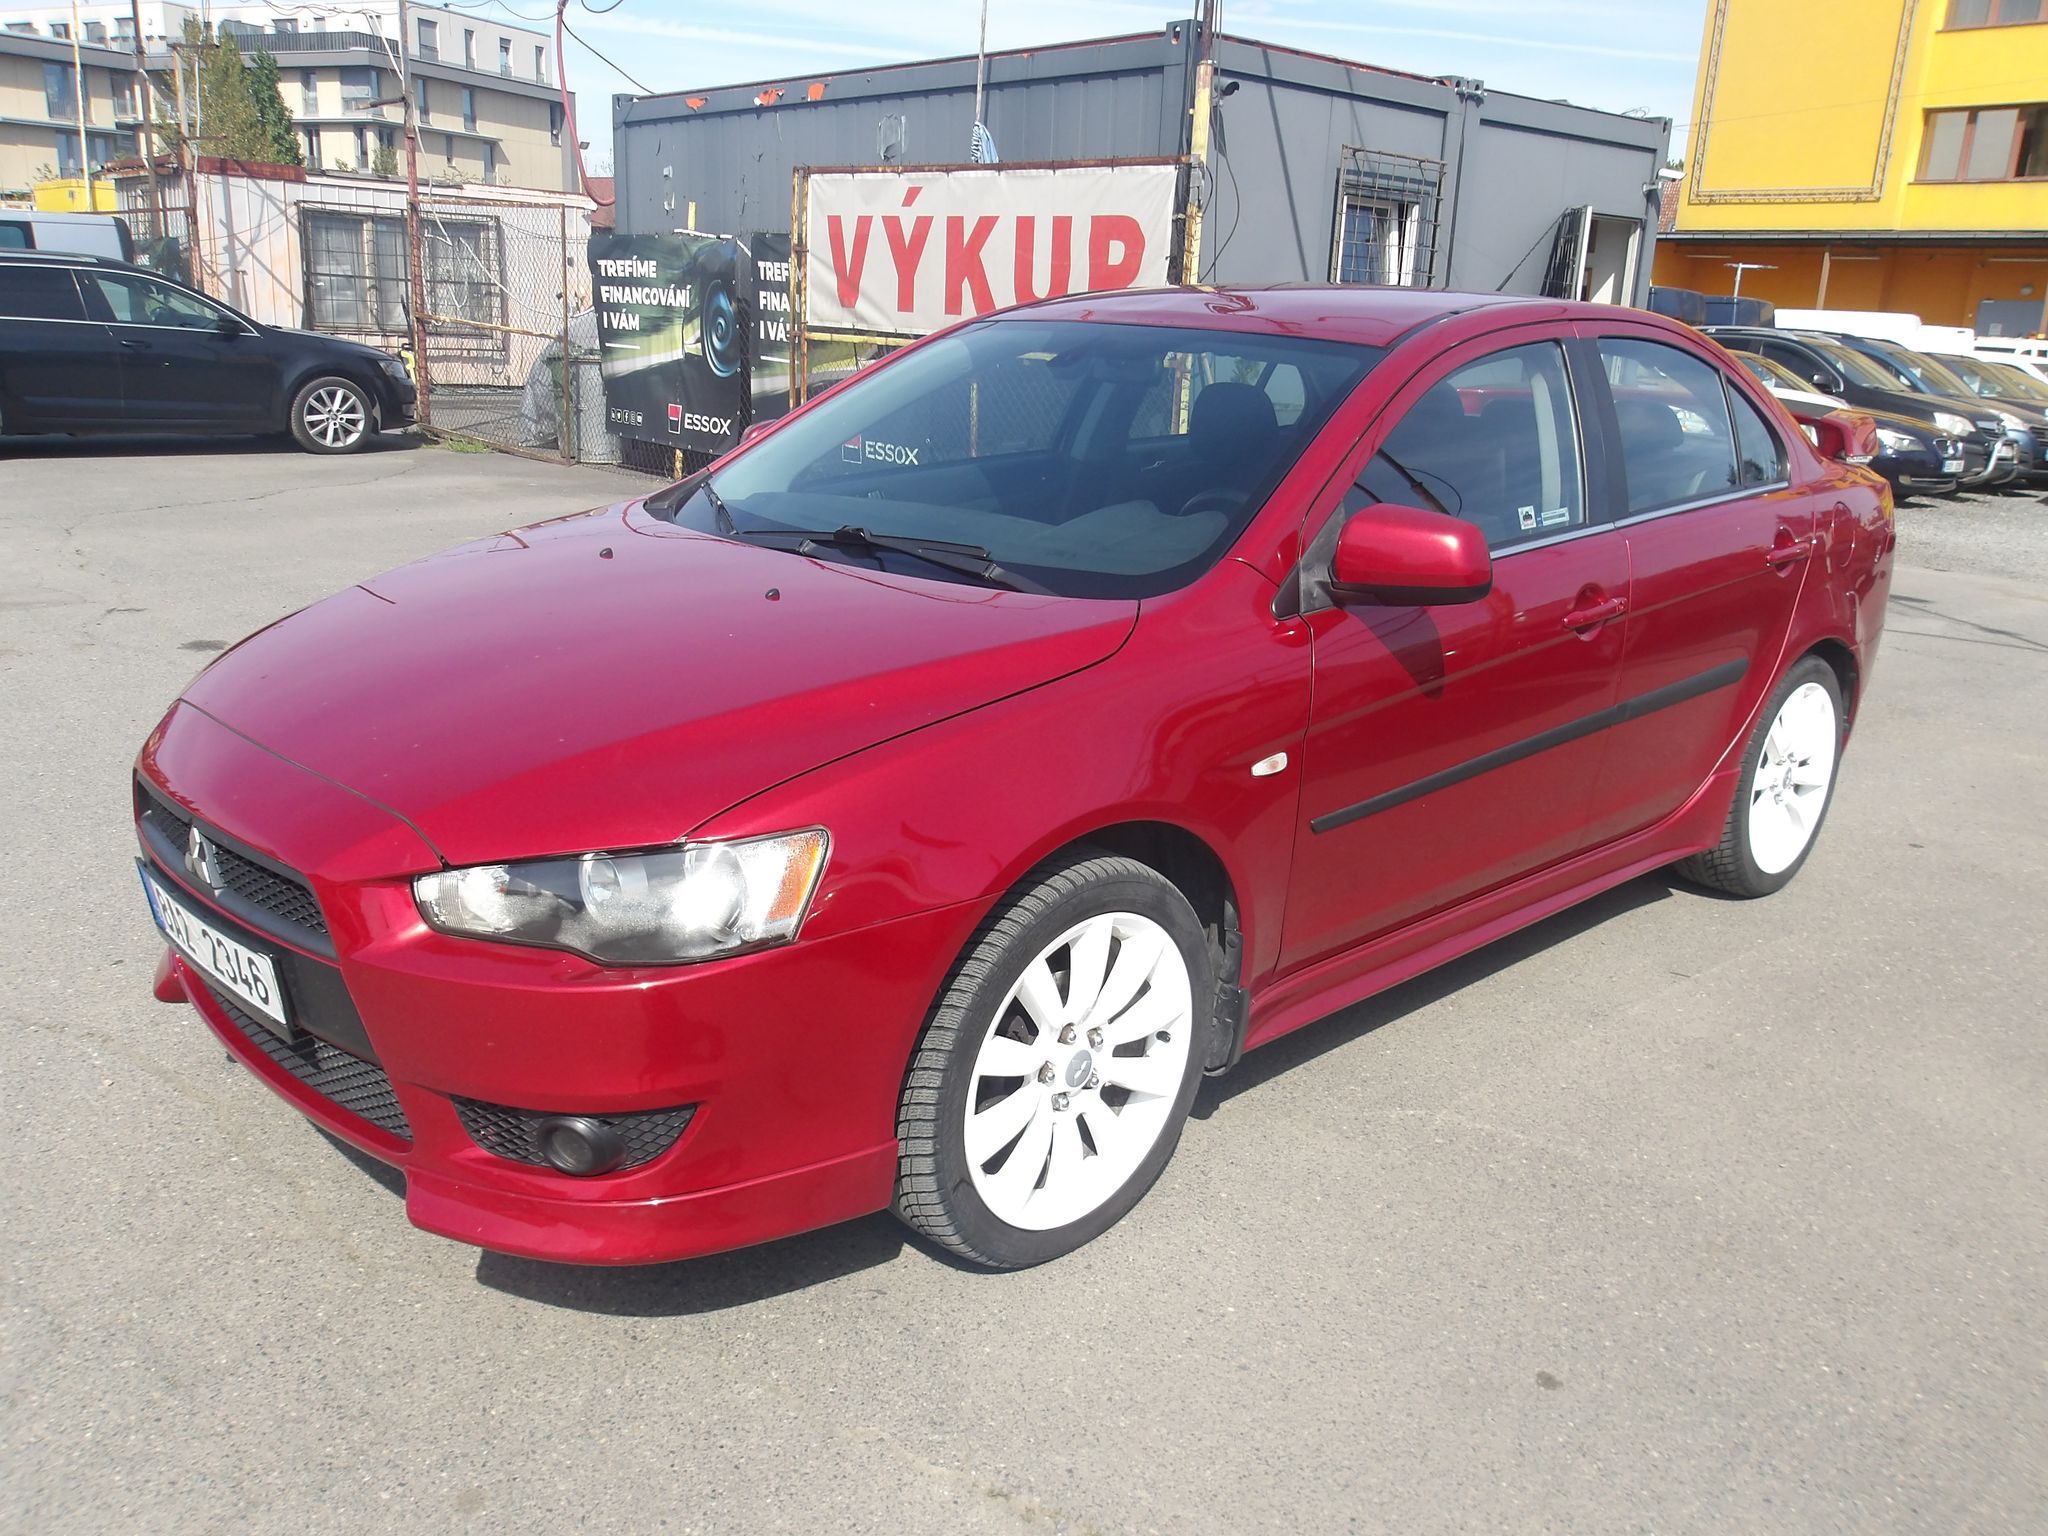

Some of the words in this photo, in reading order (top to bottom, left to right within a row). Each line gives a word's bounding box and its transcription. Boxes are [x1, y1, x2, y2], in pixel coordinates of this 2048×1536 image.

[827, 186, 1146, 315] VÝKUP
[597, 255, 657, 279] TREFÍME
[600, 284, 692, 308] FINANCOVÁNÍ
[603, 311, 608, 329] I
[610, 308, 640, 331] VÁM
[760, 320, 765, 340] I
[684, 412, 732, 436] ESSOX
[865, 440, 919, 466] ESSOX
[201, 928, 270, 1006] 2346
